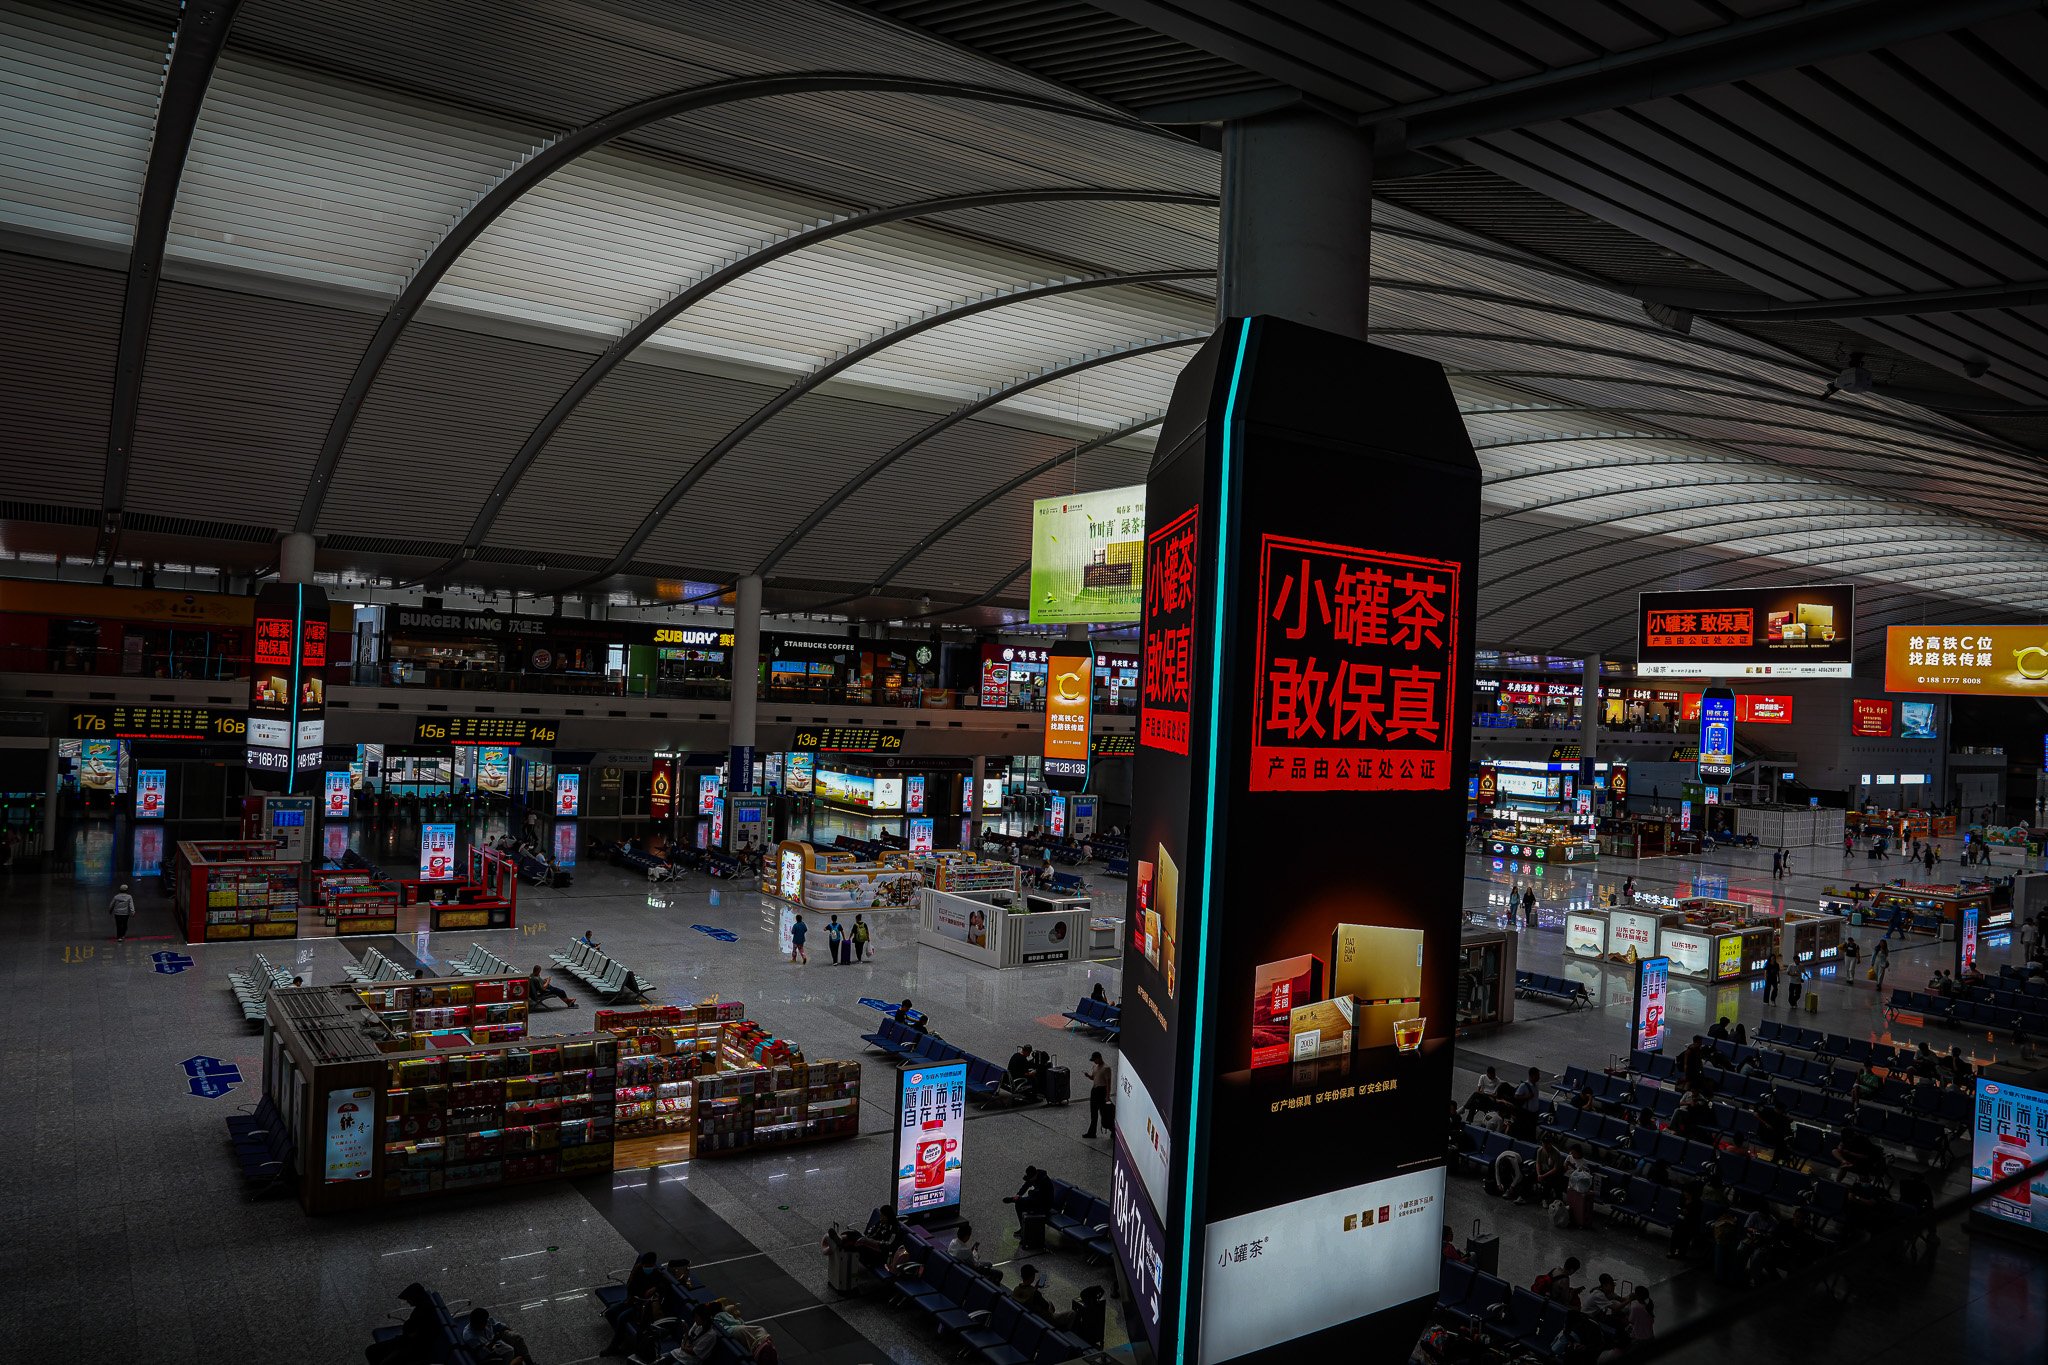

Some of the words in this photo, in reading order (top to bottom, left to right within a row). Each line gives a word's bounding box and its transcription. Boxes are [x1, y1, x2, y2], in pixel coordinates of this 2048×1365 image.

[1150, 527, 1194, 617] 小罐茶
[1272, 559, 1447, 650] 小罐茶
[258, 622, 290, 638] 小罐茶
[400, 613, 461, 630] BURGER
[464, 616, 502, 631] KING
[508, 619, 544, 634] 汉堡王
[1650, 614, 1697, 633] 小罐茶
[1701, 613, 1749, 633] 敢保真
[654, 629, 718, 645] SUBWAY
[1653, 636, 1748, 645] 产品由公证处公证
[1909, 636, 1993, 650] 抢高铁C位
[257, 639, 289, 656] 敢保真
[784, 640, 827, 649] STARBUCKS
[828, 643, 854, 651] COFFEE
[1146, 624, 1191, 703] 敢保真
[1909, 652, 1993, 667] 找路铁传媒
[1266, 657, 1442, 743] 敢保真
[73, 713, 107, 731] 17B
[214, 717, 246, 734] 16B
[418, 724, 446, 739] 15B
[529, 727, 555, 741] 14B
[796, 733, 817, 746] 13B
[881, 735, 901, 748] 12B
[1268, 757, 1437, 780] 产品由公证处公证
[1274, 983, 1290, 996] 小罐
[1300, 1038, 1314, 1048] 2003
[1280, 1095, 1312, 1111] 产地保真
[1324, 1086, 1355, 1102] 年份保真
[1367, 1079, 1398, 1094] 安全保真
